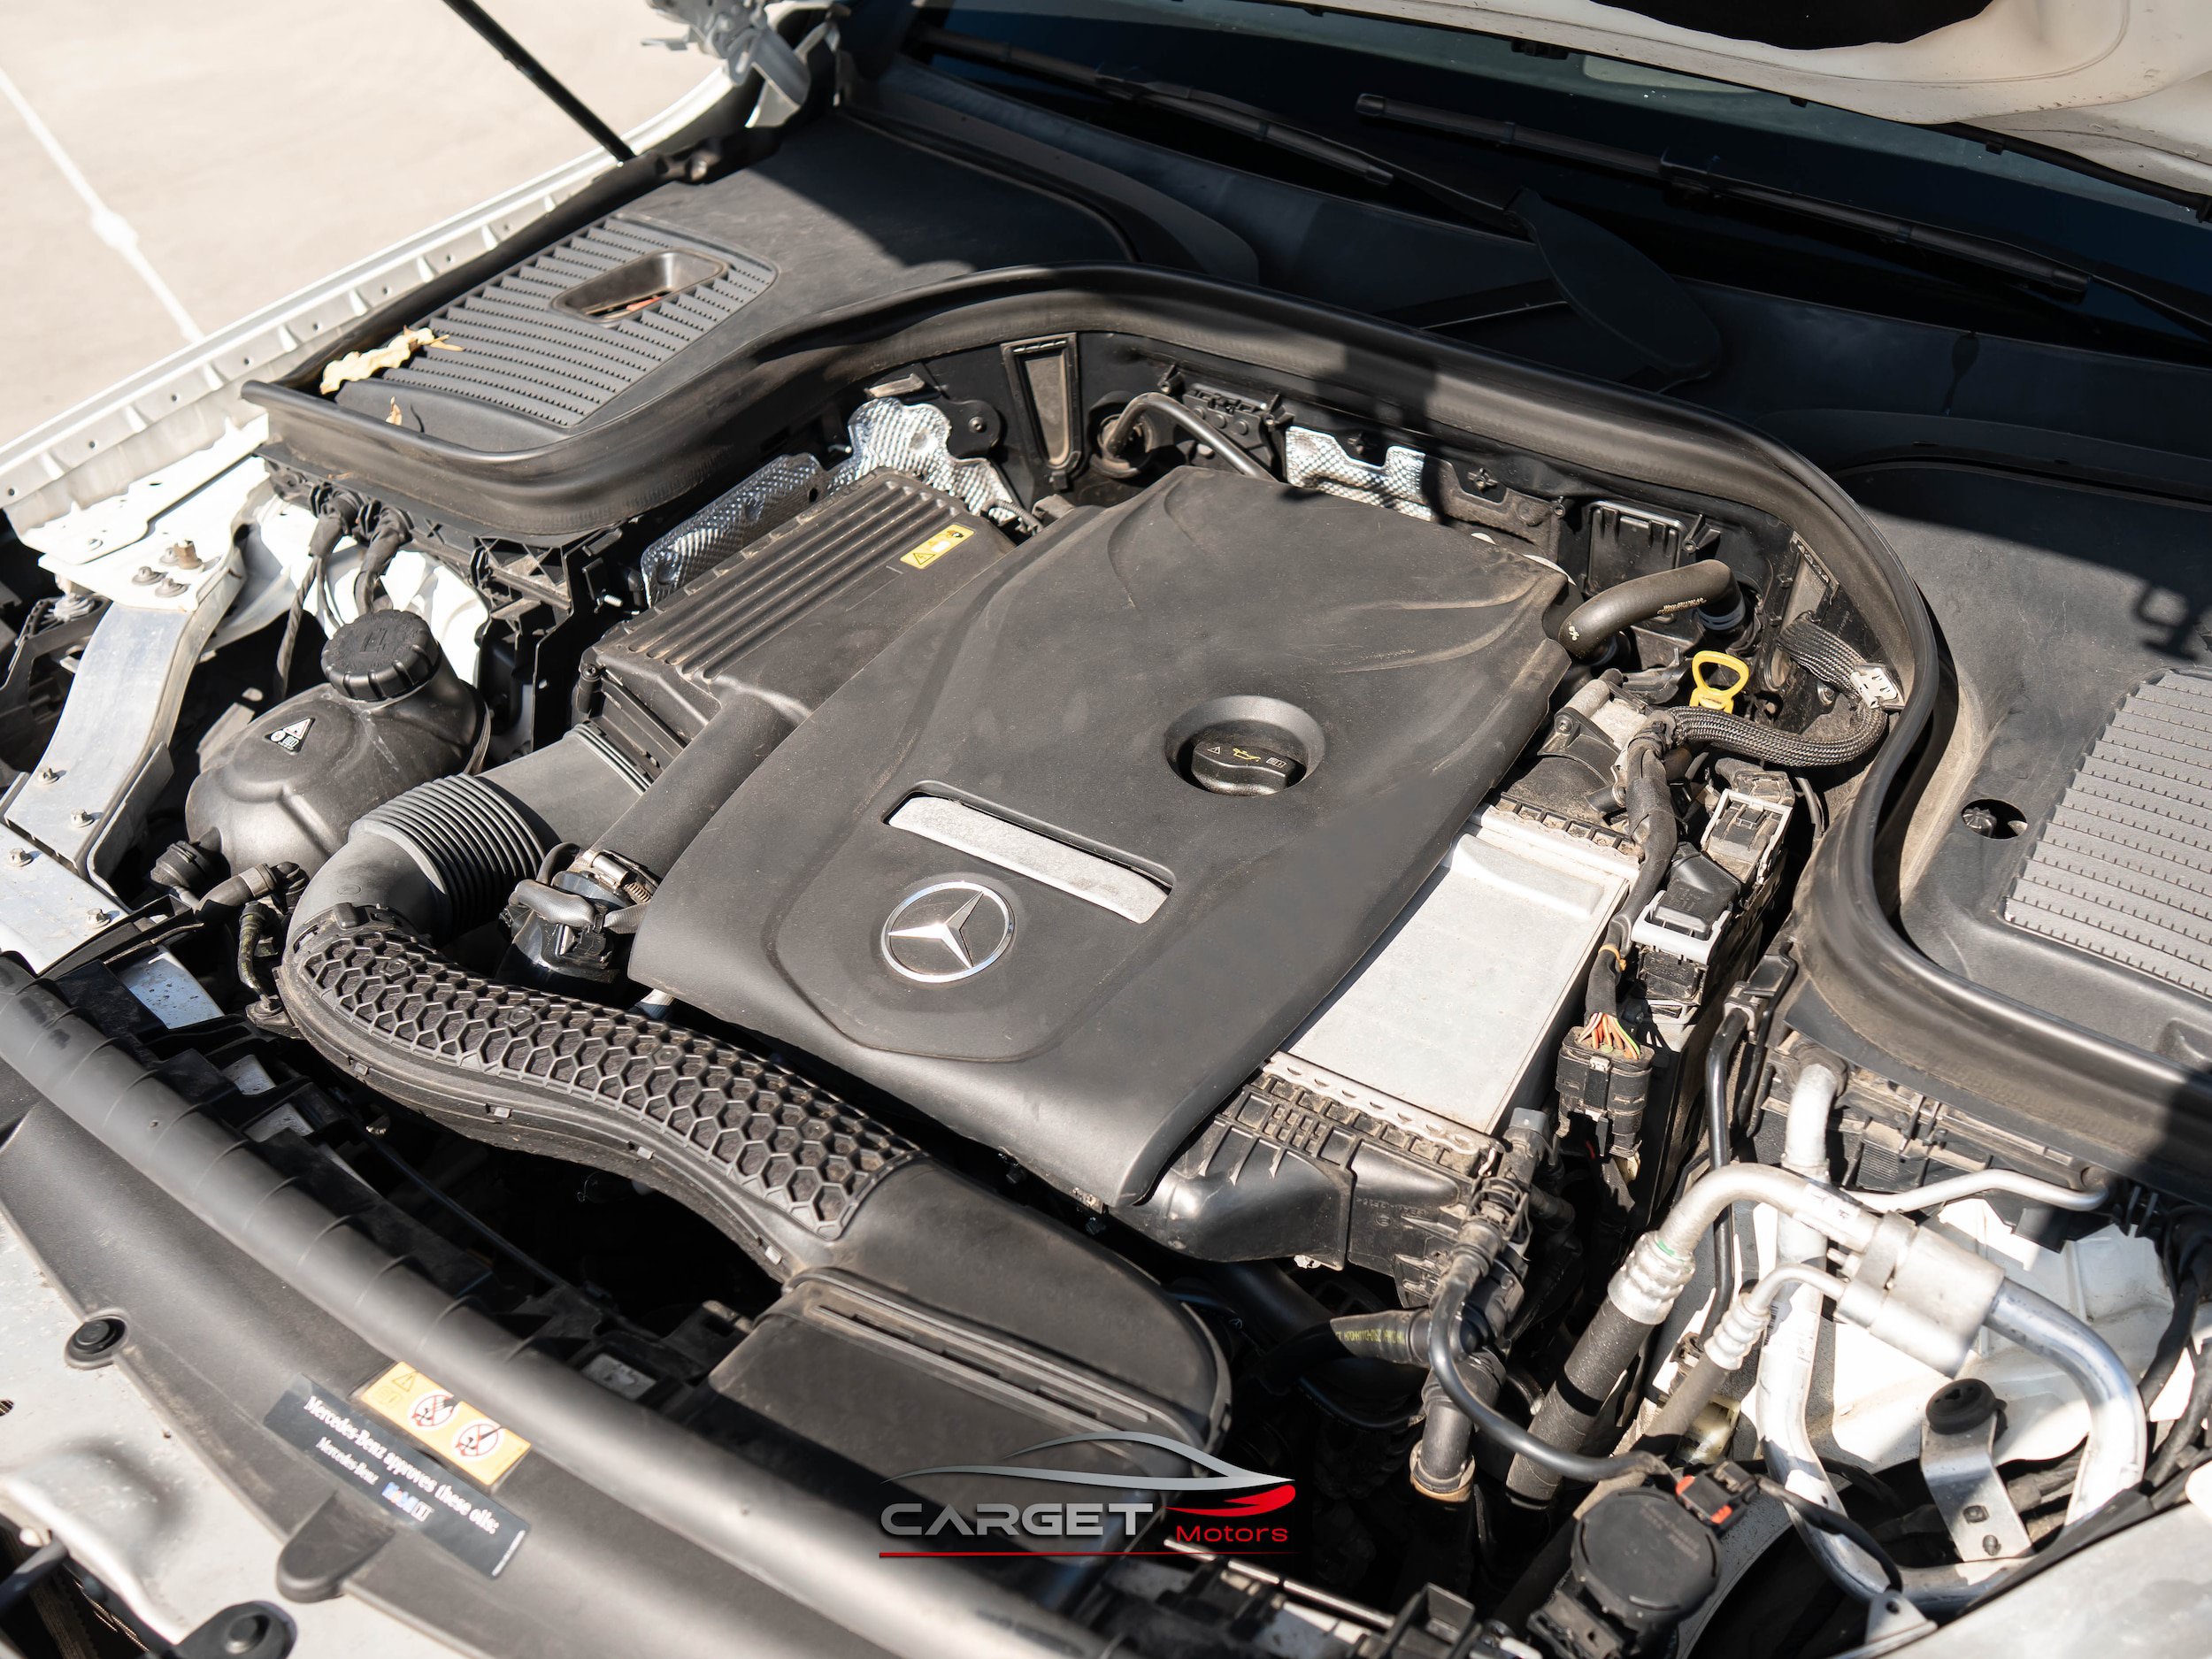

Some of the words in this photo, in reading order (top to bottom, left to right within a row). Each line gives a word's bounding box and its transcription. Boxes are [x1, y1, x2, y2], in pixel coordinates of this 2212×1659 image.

[303, 1395, 388, 1460] Mercedes-Benz
[383, 1452, 438, 1494] approves
[435, 1483, 472, 1516] these
[315, 1436, 380, 1486] Mercedes-Benz
